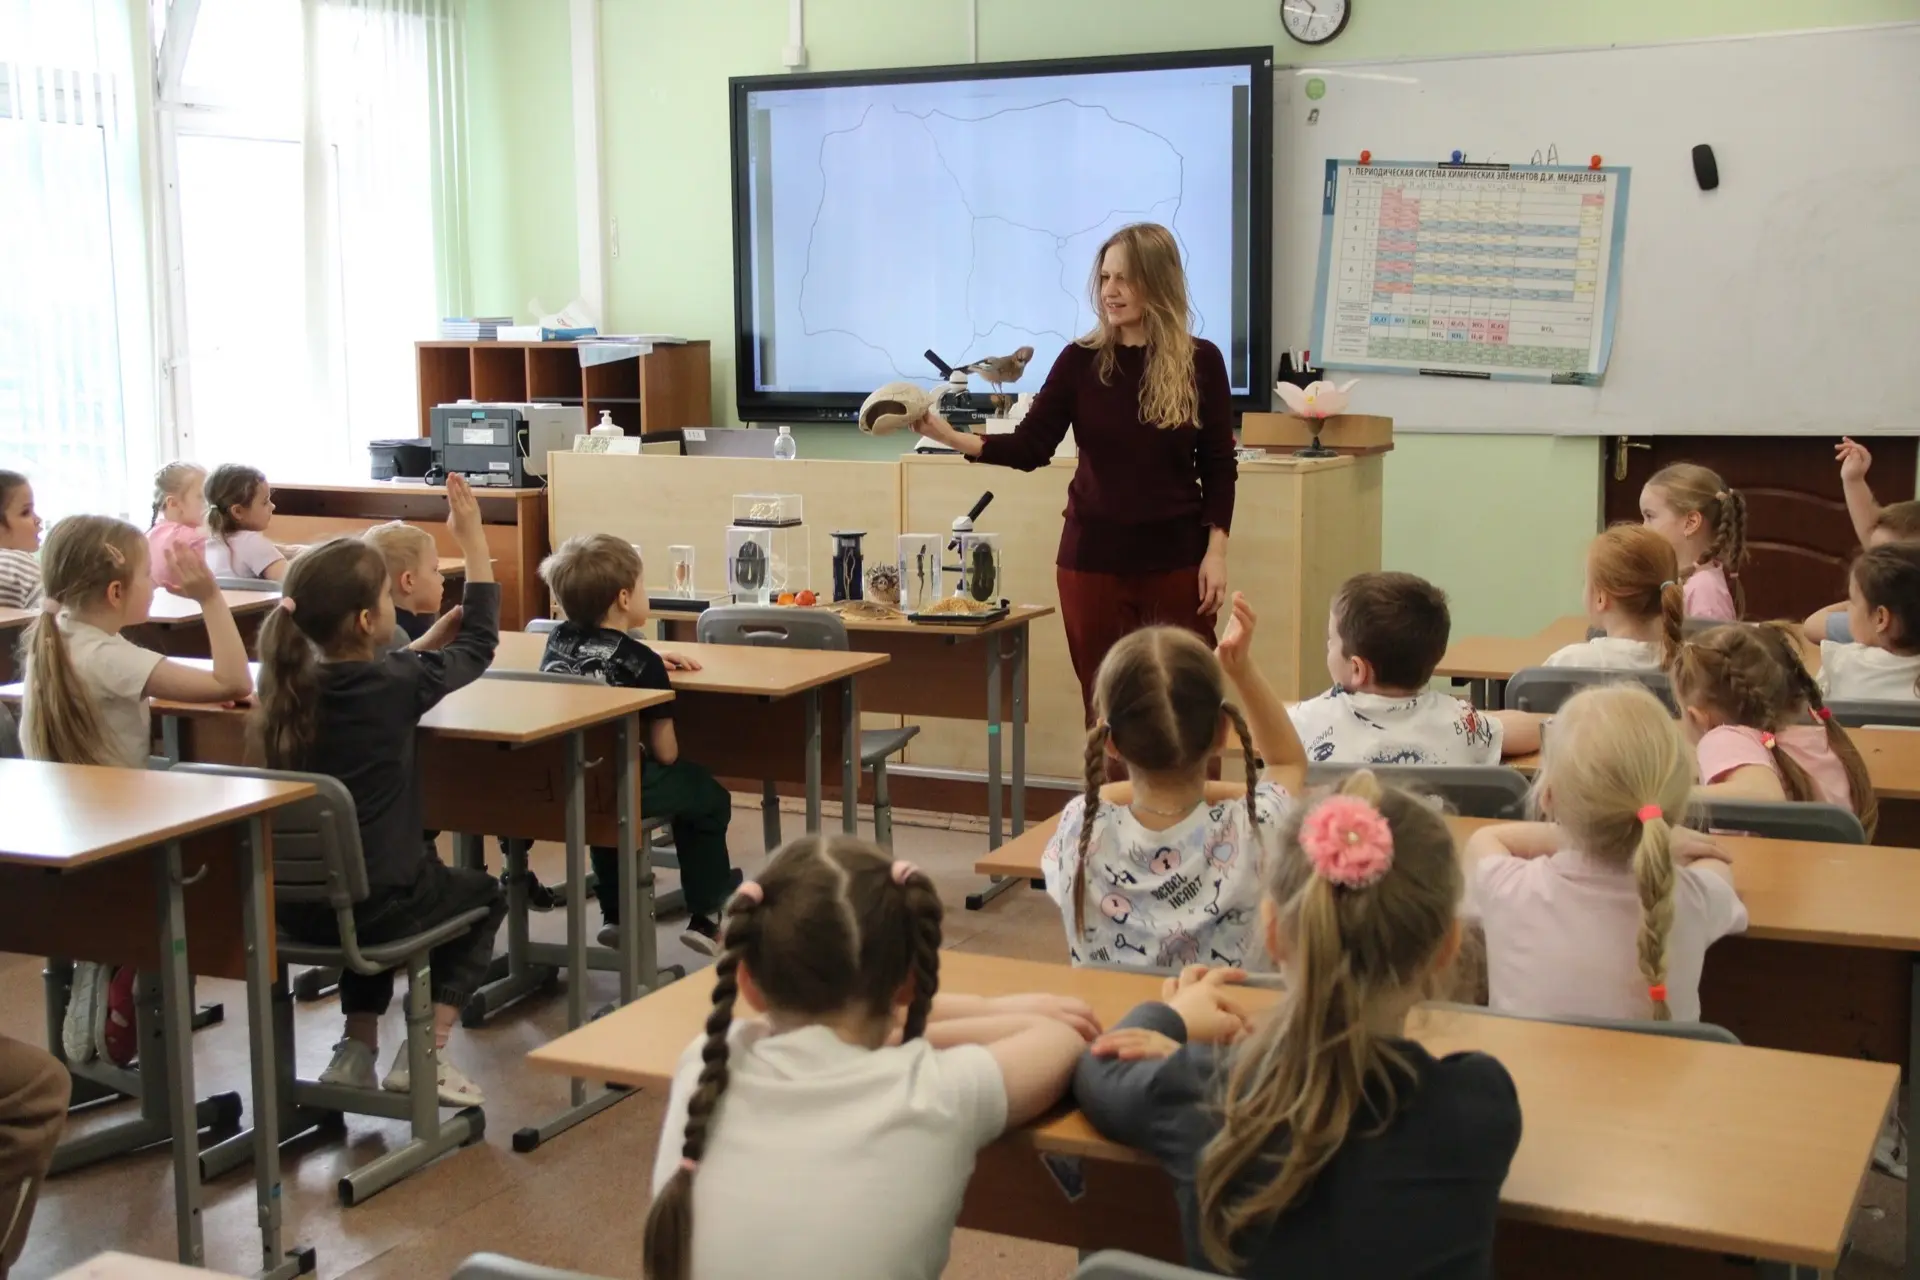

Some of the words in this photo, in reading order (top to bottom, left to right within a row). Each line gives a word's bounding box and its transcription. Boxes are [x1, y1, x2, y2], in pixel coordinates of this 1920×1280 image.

[1355, 167, 1414, 178] ПЕРИОДИЧЕСКАЯ
[1414, 168, 1446, 178] СИСТЕМА
[1447, 169, 1495, 180] ХИМИЧЕСКИХ
[1496, 171, 1539, 181] ЭЛЕМЕНТОВ
[1557, 173, 1607, 183] МЕНДЕЛЕЕВА
[1151, 872, 1188, 901] REBEL
[1168, 874, 1203, 910] HEART
